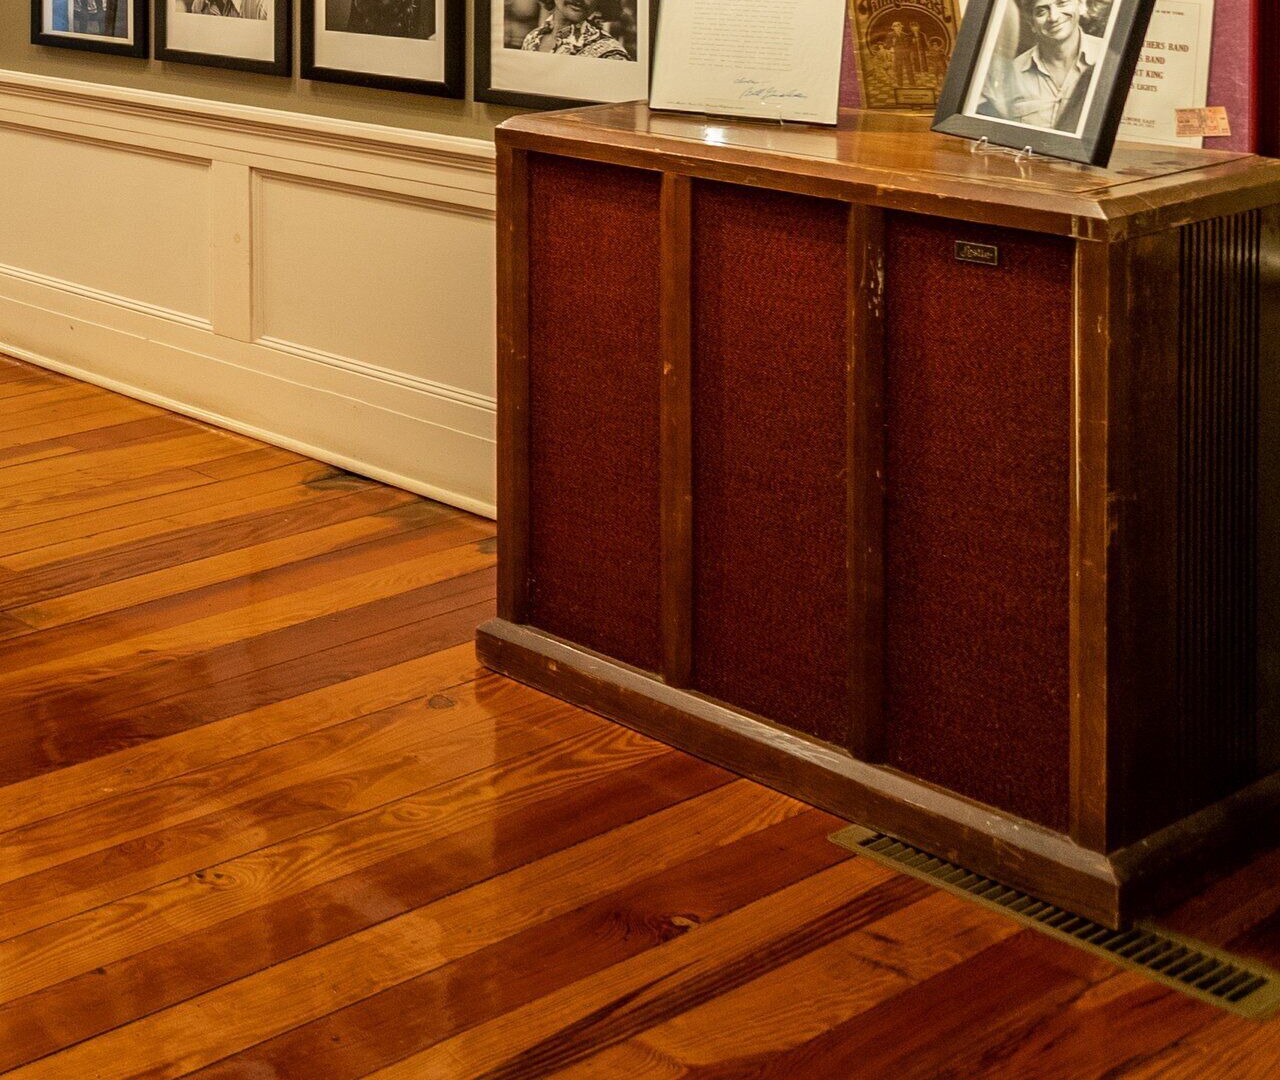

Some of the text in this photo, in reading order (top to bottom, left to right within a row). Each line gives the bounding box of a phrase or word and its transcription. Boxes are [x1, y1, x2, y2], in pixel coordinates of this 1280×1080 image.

[1168, 41, 1190, 53] BAND
[1145, 54, 1166, 65] BAND
[1146, 70, 1164, 80] KING
[1136, 84, 1158, 93] LIGHTS
